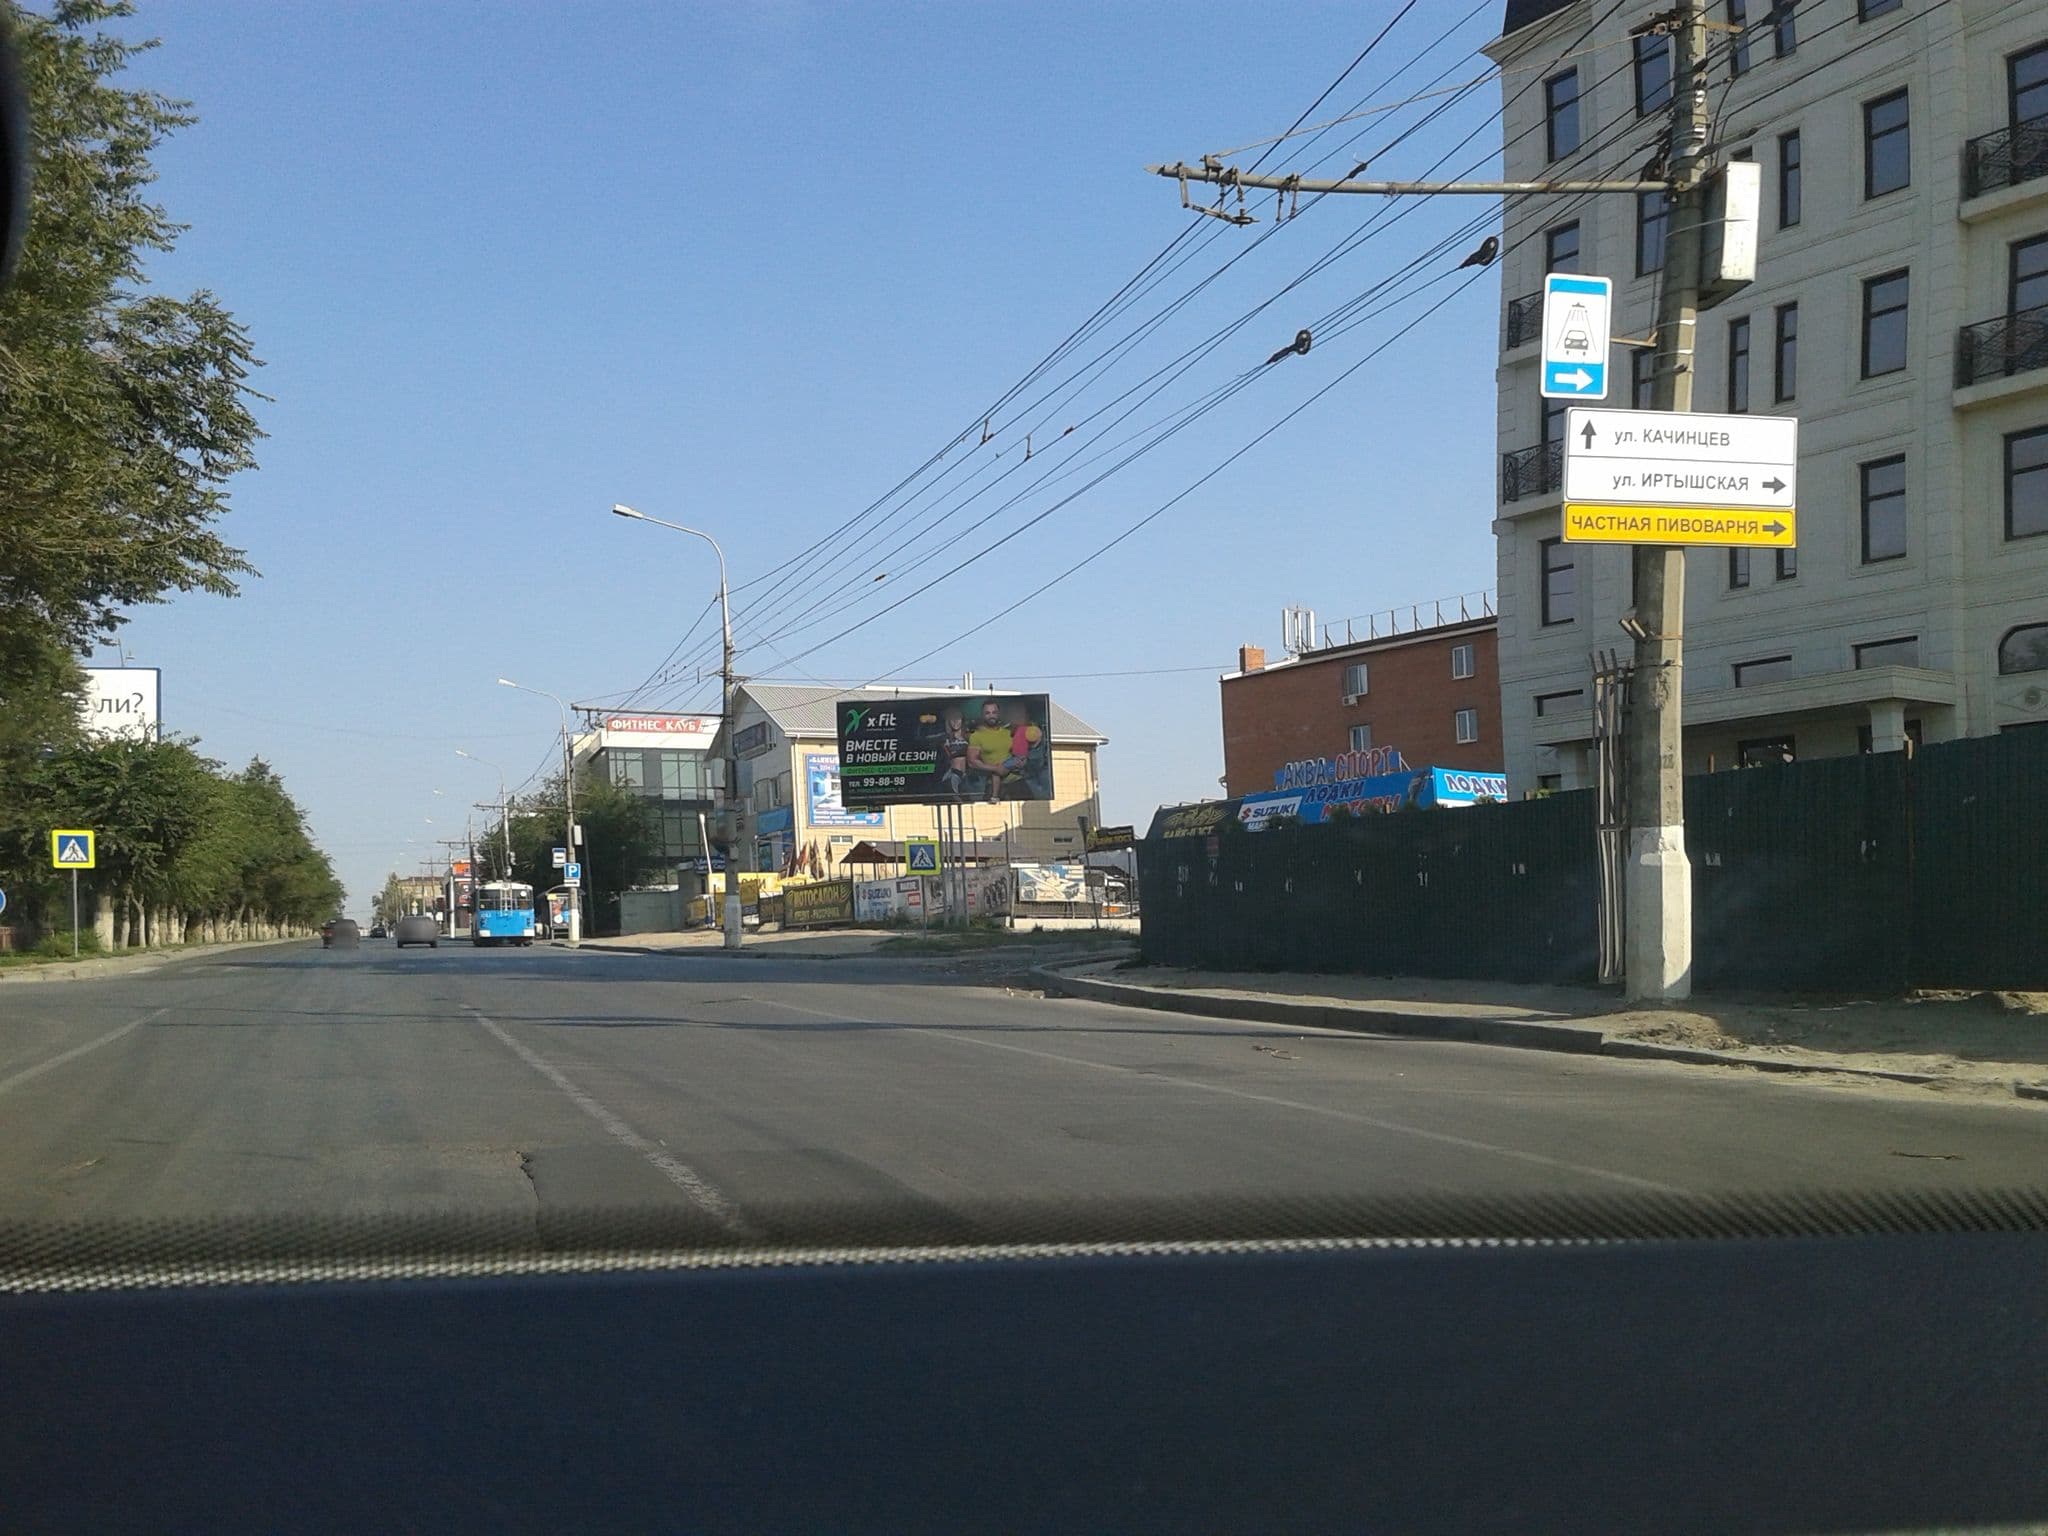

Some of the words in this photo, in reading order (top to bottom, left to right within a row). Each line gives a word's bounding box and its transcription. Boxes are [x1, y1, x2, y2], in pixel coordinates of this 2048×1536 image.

[1614, 431, 1637, 446] ул.
[1643, 428, 1731, 448] КАЧИНЦЕВ
[1612, 475, 1637, 490] ул.
[1641, 473, 1749, 491] ИРТЫШСКАЯ
[1572, 515, 1651, 532] ЧАСТНАЯ
[1656, 517, 1759, 535] ПИВОВАРНЯ
[97, 692, 144, 714] ли?
[611, 719, 662, 730] ФИТНЕС
[666, 718, 697, 731] КЛУБ
[845, 739, 898, 752] ВМЕСТЕ
[846, 753, 855, 764] В
[857, 751, 897, 763] НОВЫЙ
[899, 751, 938, 761] СЕЗОН!
[1283, 757, 1329, 790] АКВА
[1335, 745, 1393, 782] СПОРТ
[1303, 780, 1365, 805] ЛОДКИ
[1253, 803, 1296, 818] SUZUKI
